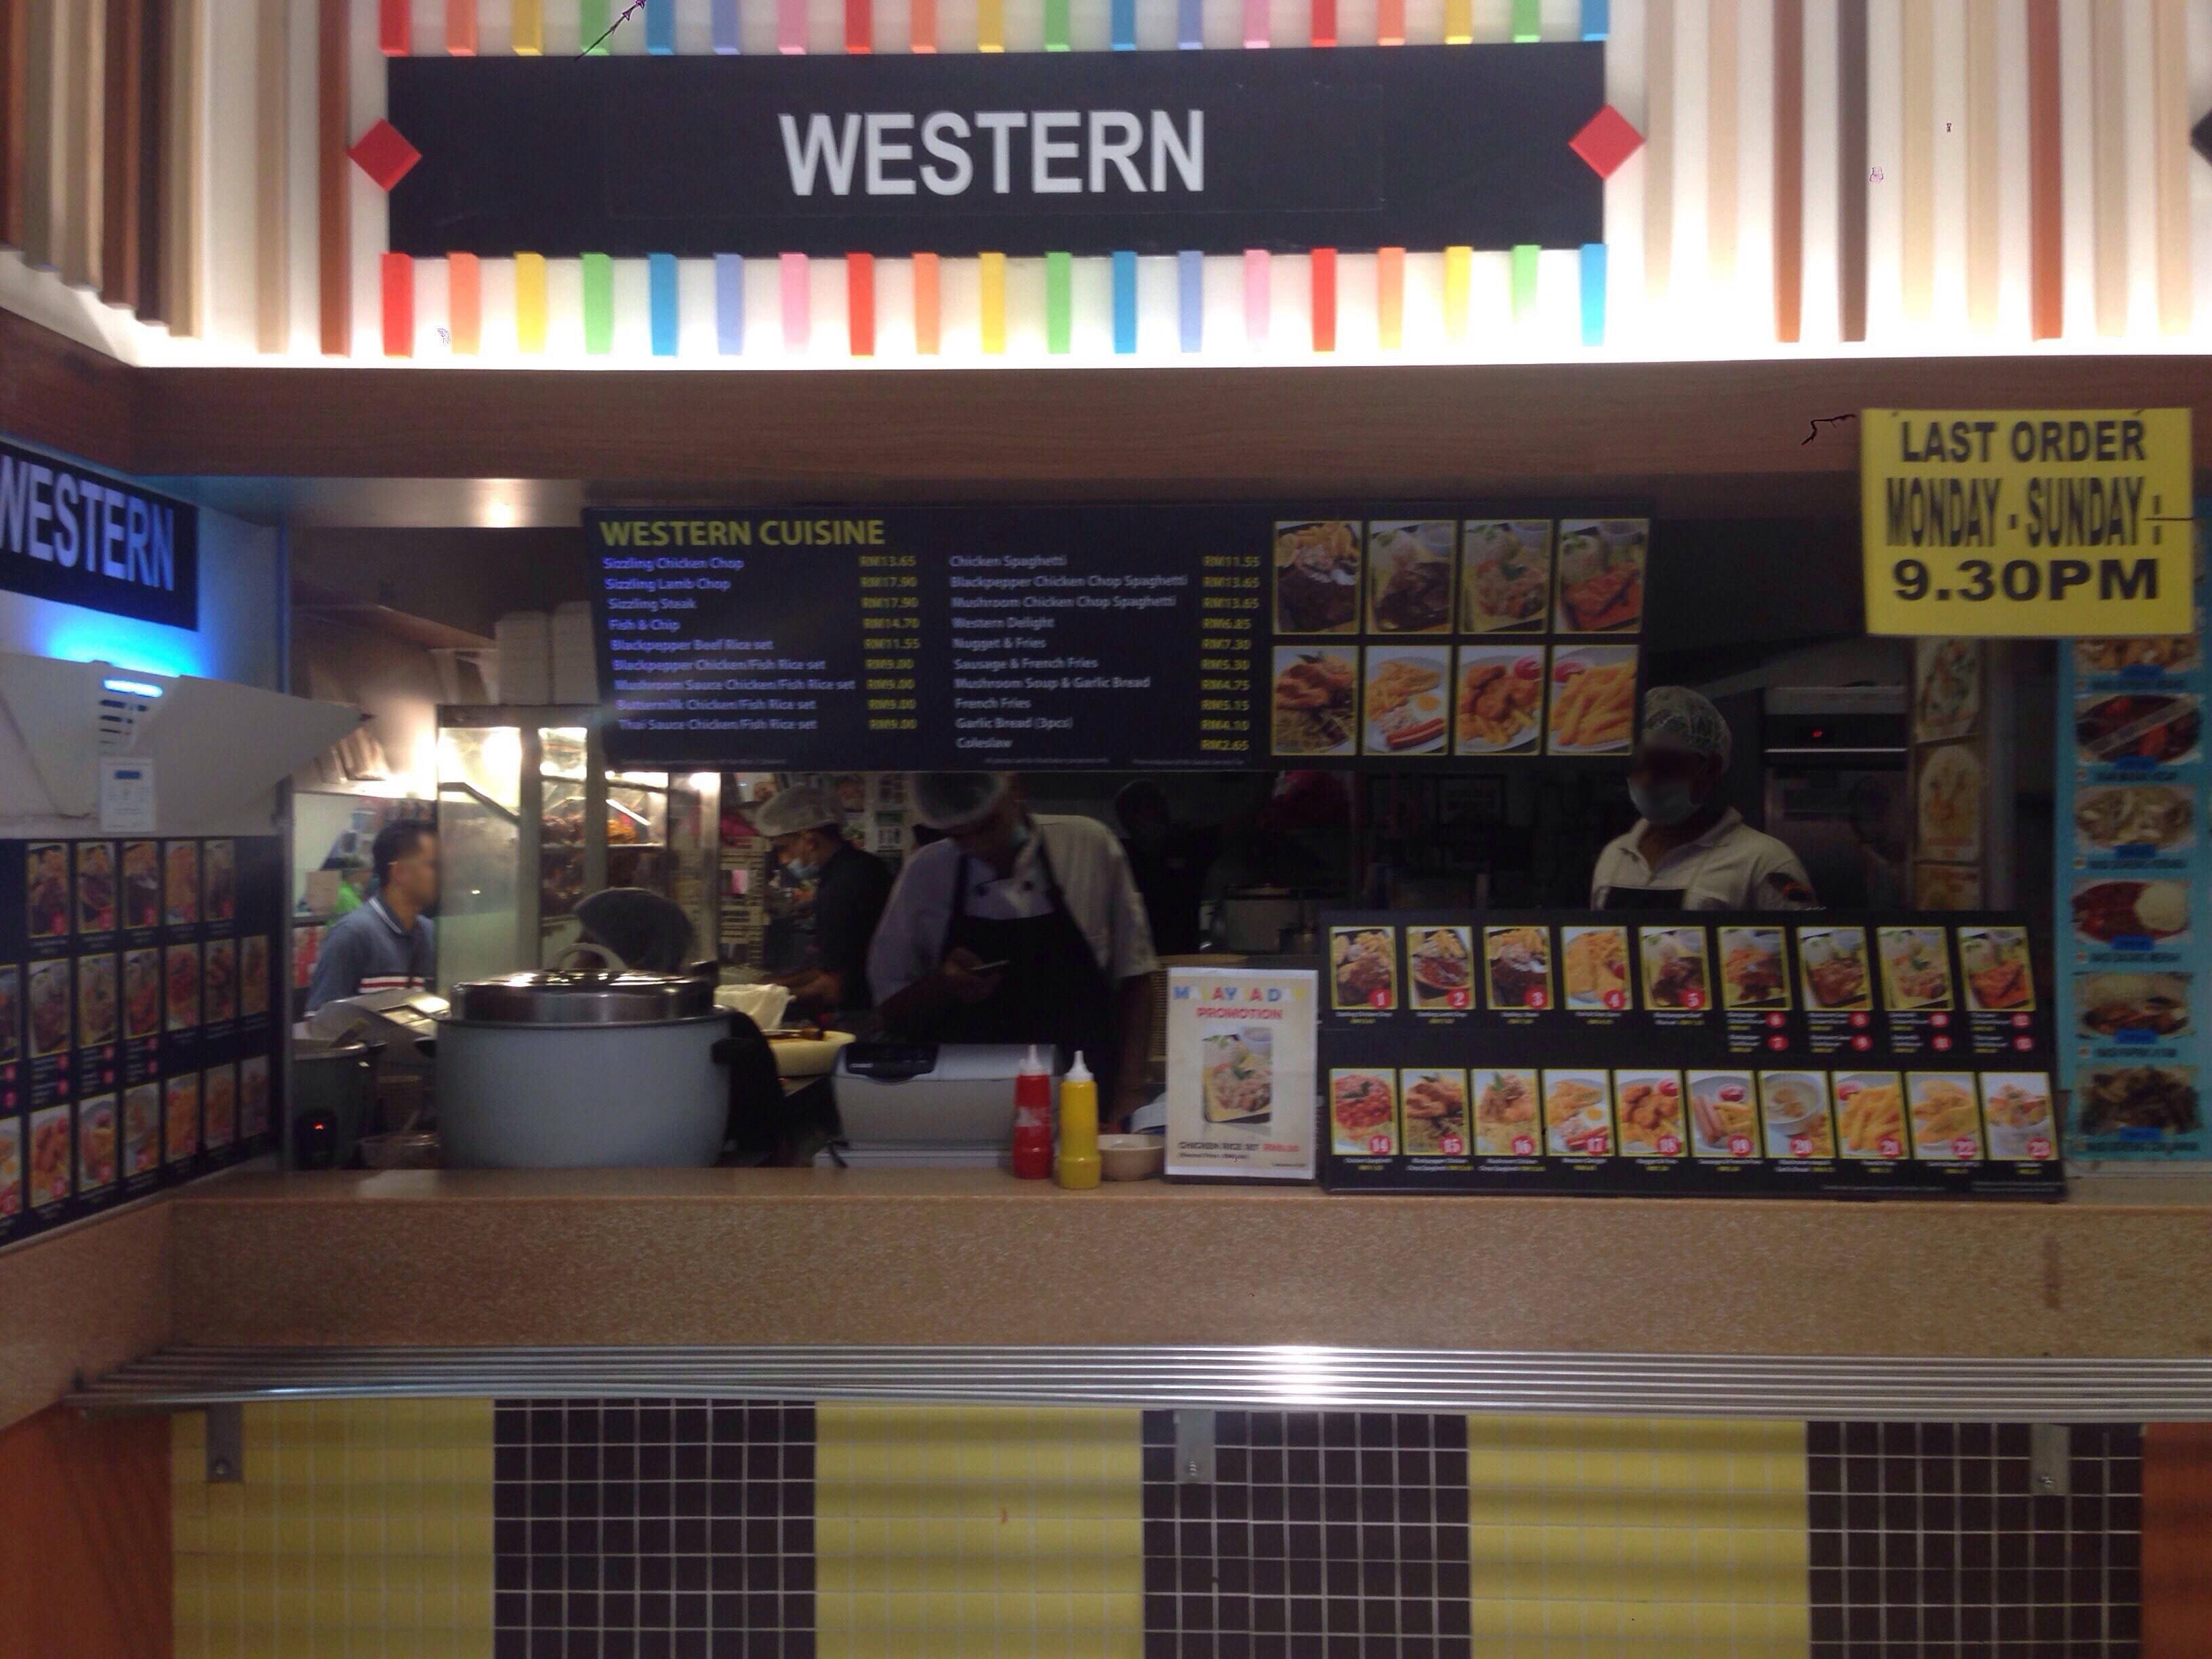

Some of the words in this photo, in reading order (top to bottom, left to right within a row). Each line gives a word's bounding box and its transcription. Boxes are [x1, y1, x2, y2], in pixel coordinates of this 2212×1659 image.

[777, 110, 1204, 196] WESTERN
[1901, 420, 1999, 464] LAST
[2011, 420, 2147, 463] ORDER
[1886, 476, 2001, 548] MONDAY
[599, 520, 752, 547] WESTERN
[758, 519, 886, 546] CUISINE
[602, 558, 655, 572] Sizzling
[655, 558, 708, 569] Chicken
[709, 558, 744, 571] Chop
[949, 556, 1002, 567] Chicken
[1003, 556, 1067, 569] Spaghetti
[604, 578, 656, 592] Sizzling
[657, 578, 695, 589] Lamb
[696, 578, 731, 592] Chop
[950, 575, 1031, 590] Blackpepper
[1033, 575, 1084, 587] Chicken
[1086, 575, 1122, 589] Chop
[1123, 575, 1188, 590] Spaghetti
[1892, 558, 2158, 602] 9.30PM
[607, 598, 658, 612] Sizzling
[659, 598, 697, 609] Steak
[951, 597, 1021, 608] Mushroom
[1023, 596, 1075, 607] Chicken
[1076, 596, 1110, 609] Chop
[1111, 596, 1177, 609] Spaghetti
[608, 619, 637, 630] Fish
[650, 619, 680, 633] Chip
[951, 617, 1005, 628] Western
[1006, 617, 1055, 630] Delight
[610, 639, 691, 653] Blackpepper
[951, 638, 1001, 651] Nugget
[1015, 638, 1047, 649] Fries
[612, 659, 693, 673] Blackpepper
[954, 659, 1008, 672] Sausage
[1021, 657, 1066, 669] French
[1067, 657, 1099, 669] Fries
[684, 680, 723, 690] Sauce
[954, 678, 1023, 689] Mushroom
[1025, 678, 1059, 691] Soup
[1073, 677, 1111, 688] Garlic
[1112, 677, 1151, 688] Bread
[954, 698, 1000, 709] French
[1000, 698, 1032, 709] Fries
[647, 719, 685, 730] Sauce
[954, 718, 994, 729] Garlic
[994, 718, 1032, 729] Bread
[955, 738, 1013, 748] Coleslaw
[1173, 986, 1263, 1002] MLAYIA
[1267, 987, 1307, 1002] DY
[1453, 991, 1465, 1006] 2
[1688, 992, 1698, 1007] 5
[1196, 1007, 1282, 1019] PROMOTION
